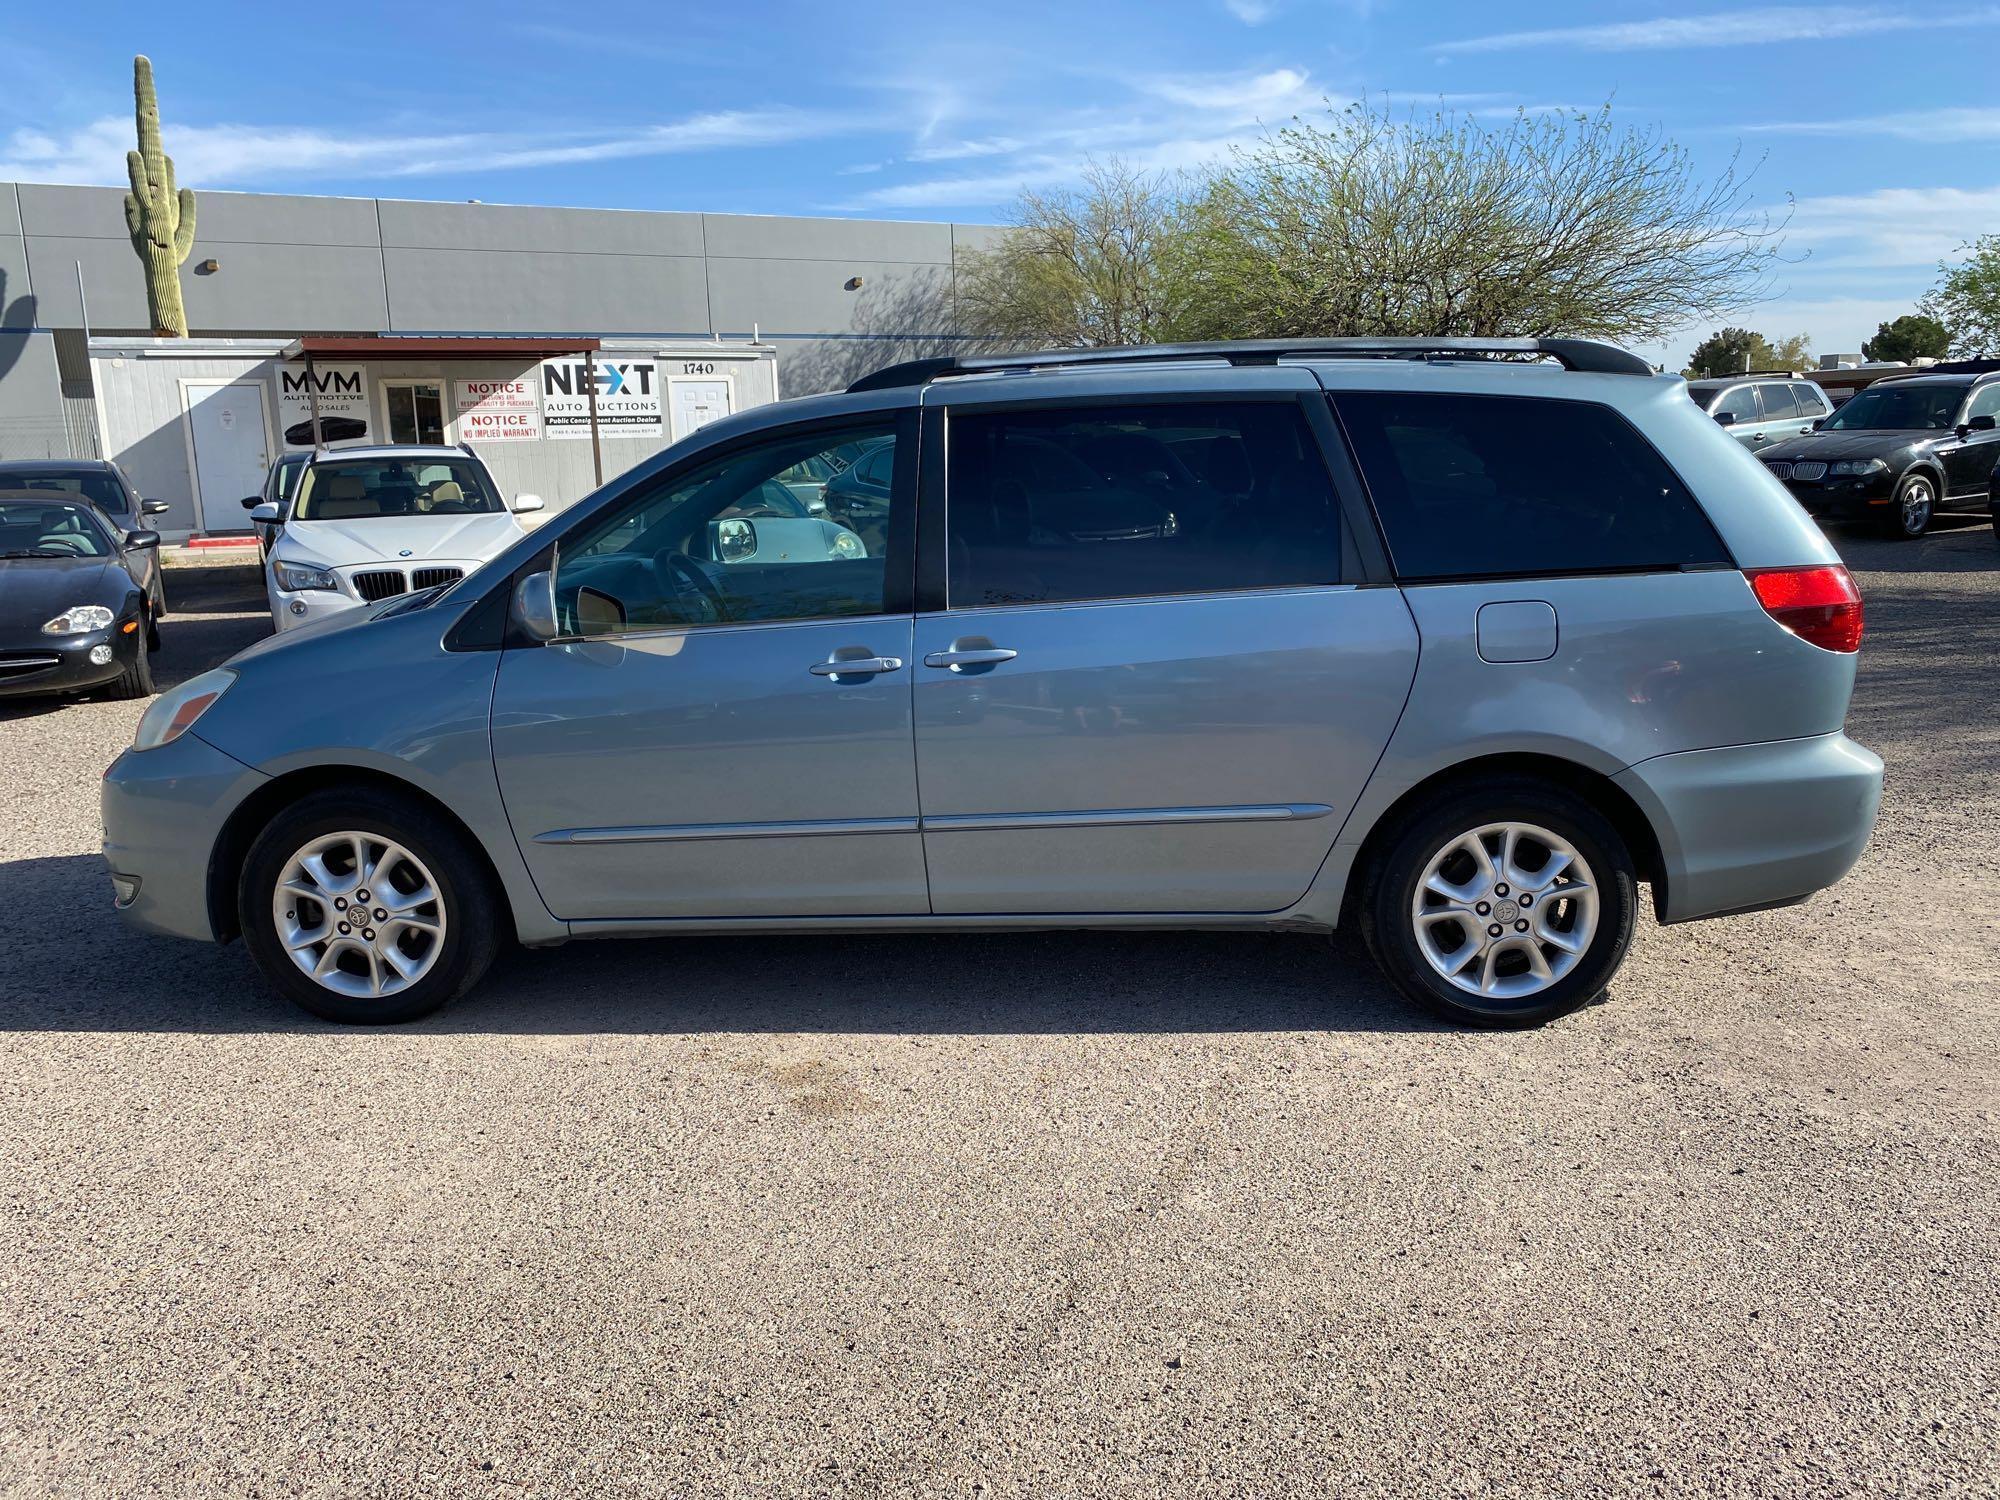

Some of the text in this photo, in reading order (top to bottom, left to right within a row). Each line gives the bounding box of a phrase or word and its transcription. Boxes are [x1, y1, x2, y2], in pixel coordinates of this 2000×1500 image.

[683, 363, 714, 374] 1740
[282, 371, 361, 393] MVM
[543, 364, 654, 395] NEXT
[468, 383, 524, 393] NOTICE
[547, 402, 657, 411] AUTO UCTIONS
[471, 415, 527, 425] NOTICE
[463, 428, 537, 439] NO IMPLIED WARRANTY
